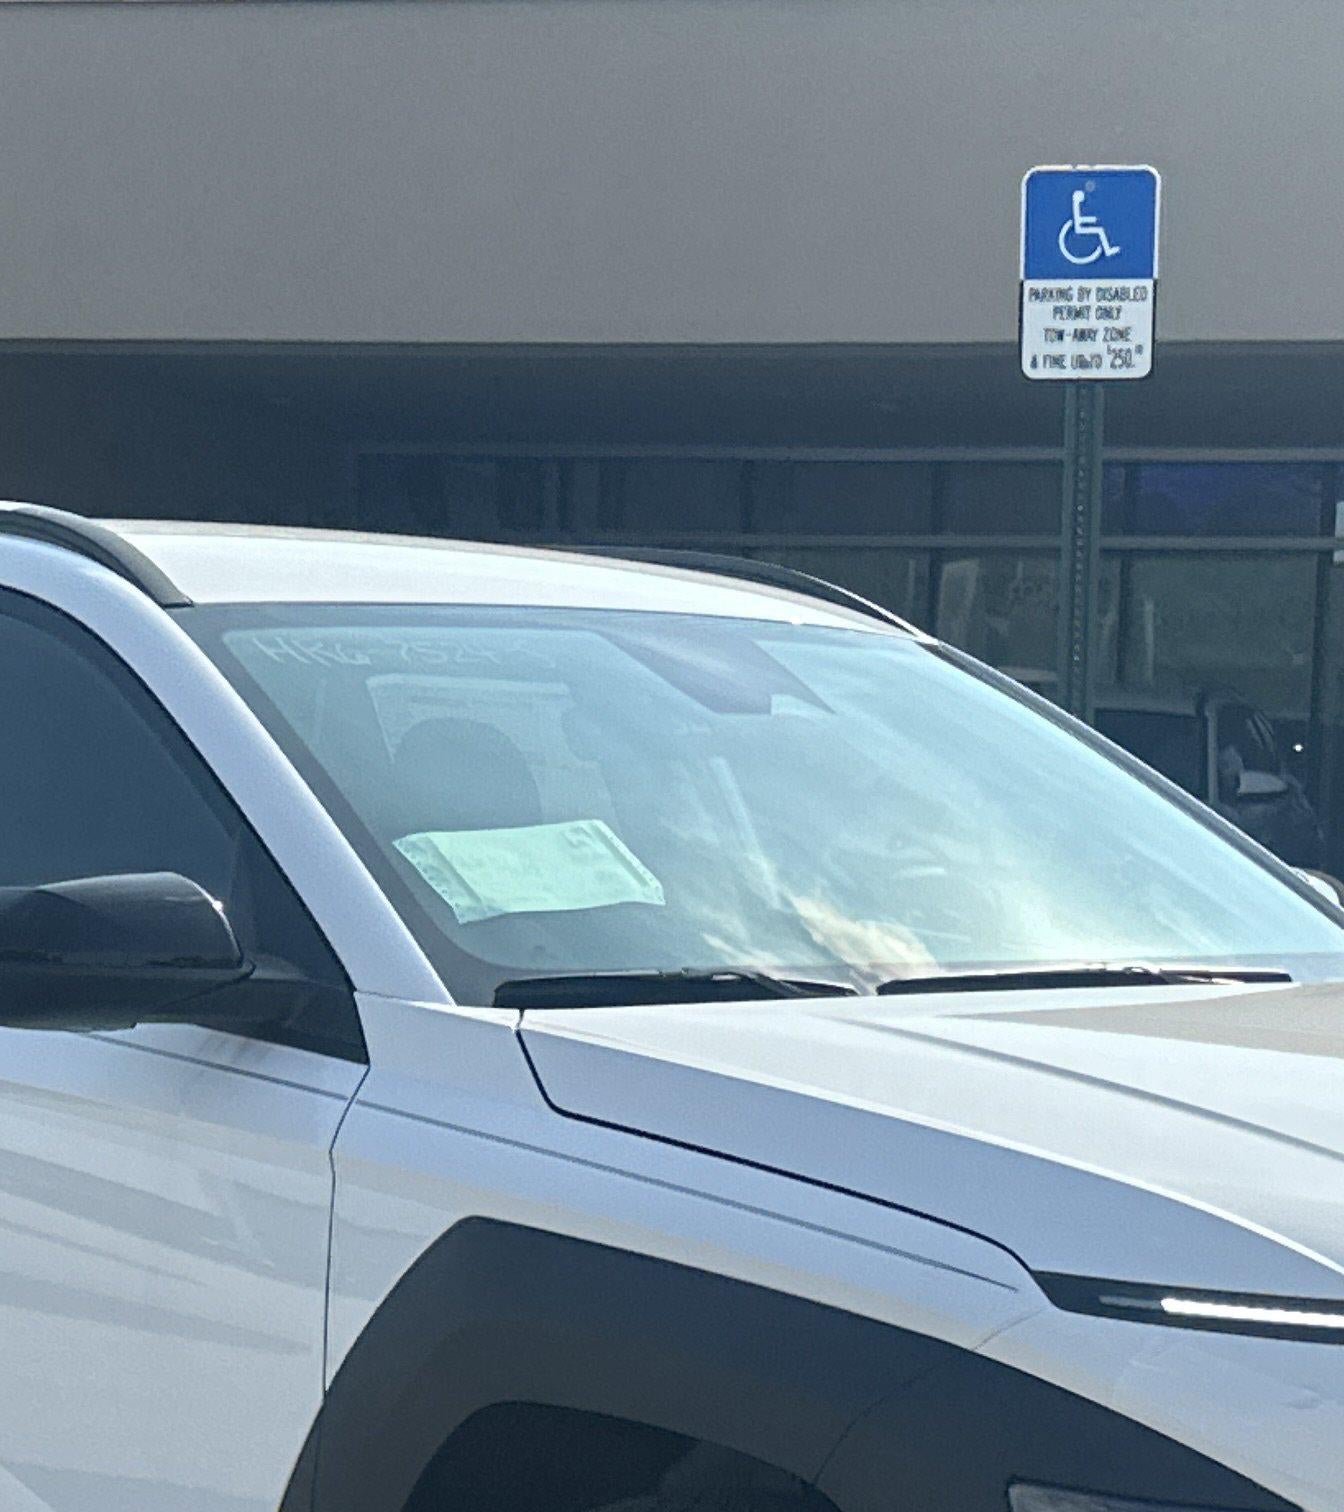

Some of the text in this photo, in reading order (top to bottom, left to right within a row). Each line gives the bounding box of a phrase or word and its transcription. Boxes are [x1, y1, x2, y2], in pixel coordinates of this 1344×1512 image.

[1028, 285, 1148, 302] PARKING BY DISABLED
[1053, 305, 1122, 321] PERMIT ONLY
[1043, 326, 1132, 343] TOW-AWAY ZONE
[1043, 354, 1066, 369] FINE
